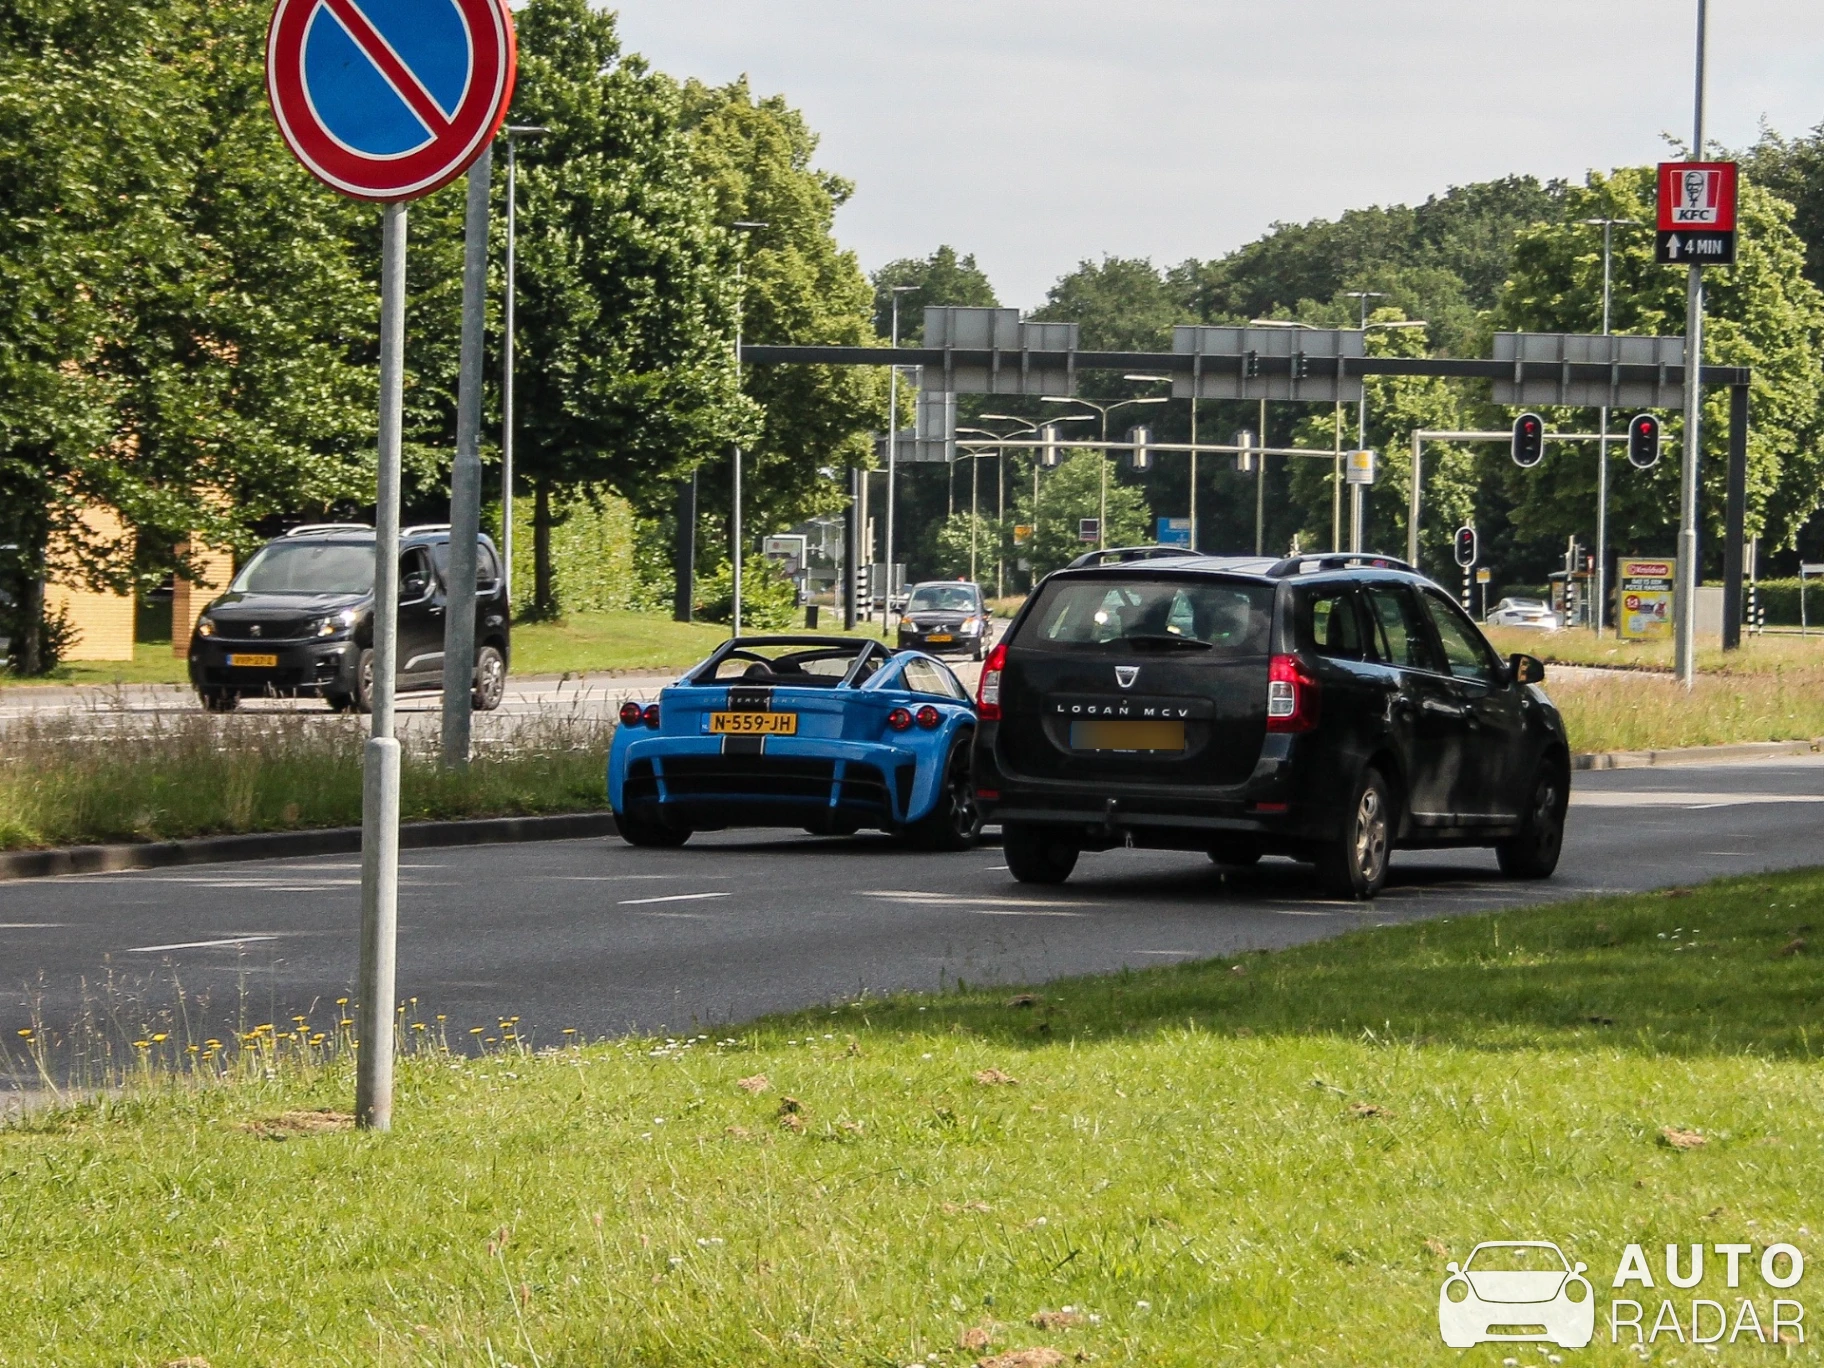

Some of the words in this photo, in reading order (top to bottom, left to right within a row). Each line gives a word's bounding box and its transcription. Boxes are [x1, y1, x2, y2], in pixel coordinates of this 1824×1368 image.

[1678, 209, 1710, 221] KFC
[1684, 239, 1695, 254] 4
[1697, 239, 1722, 254] MIN
[1057, 704, 1129, 715] LOGAN
[1143, 708, 1188, 717] MCV
[714, 715, 791, 731] N-559-JH
